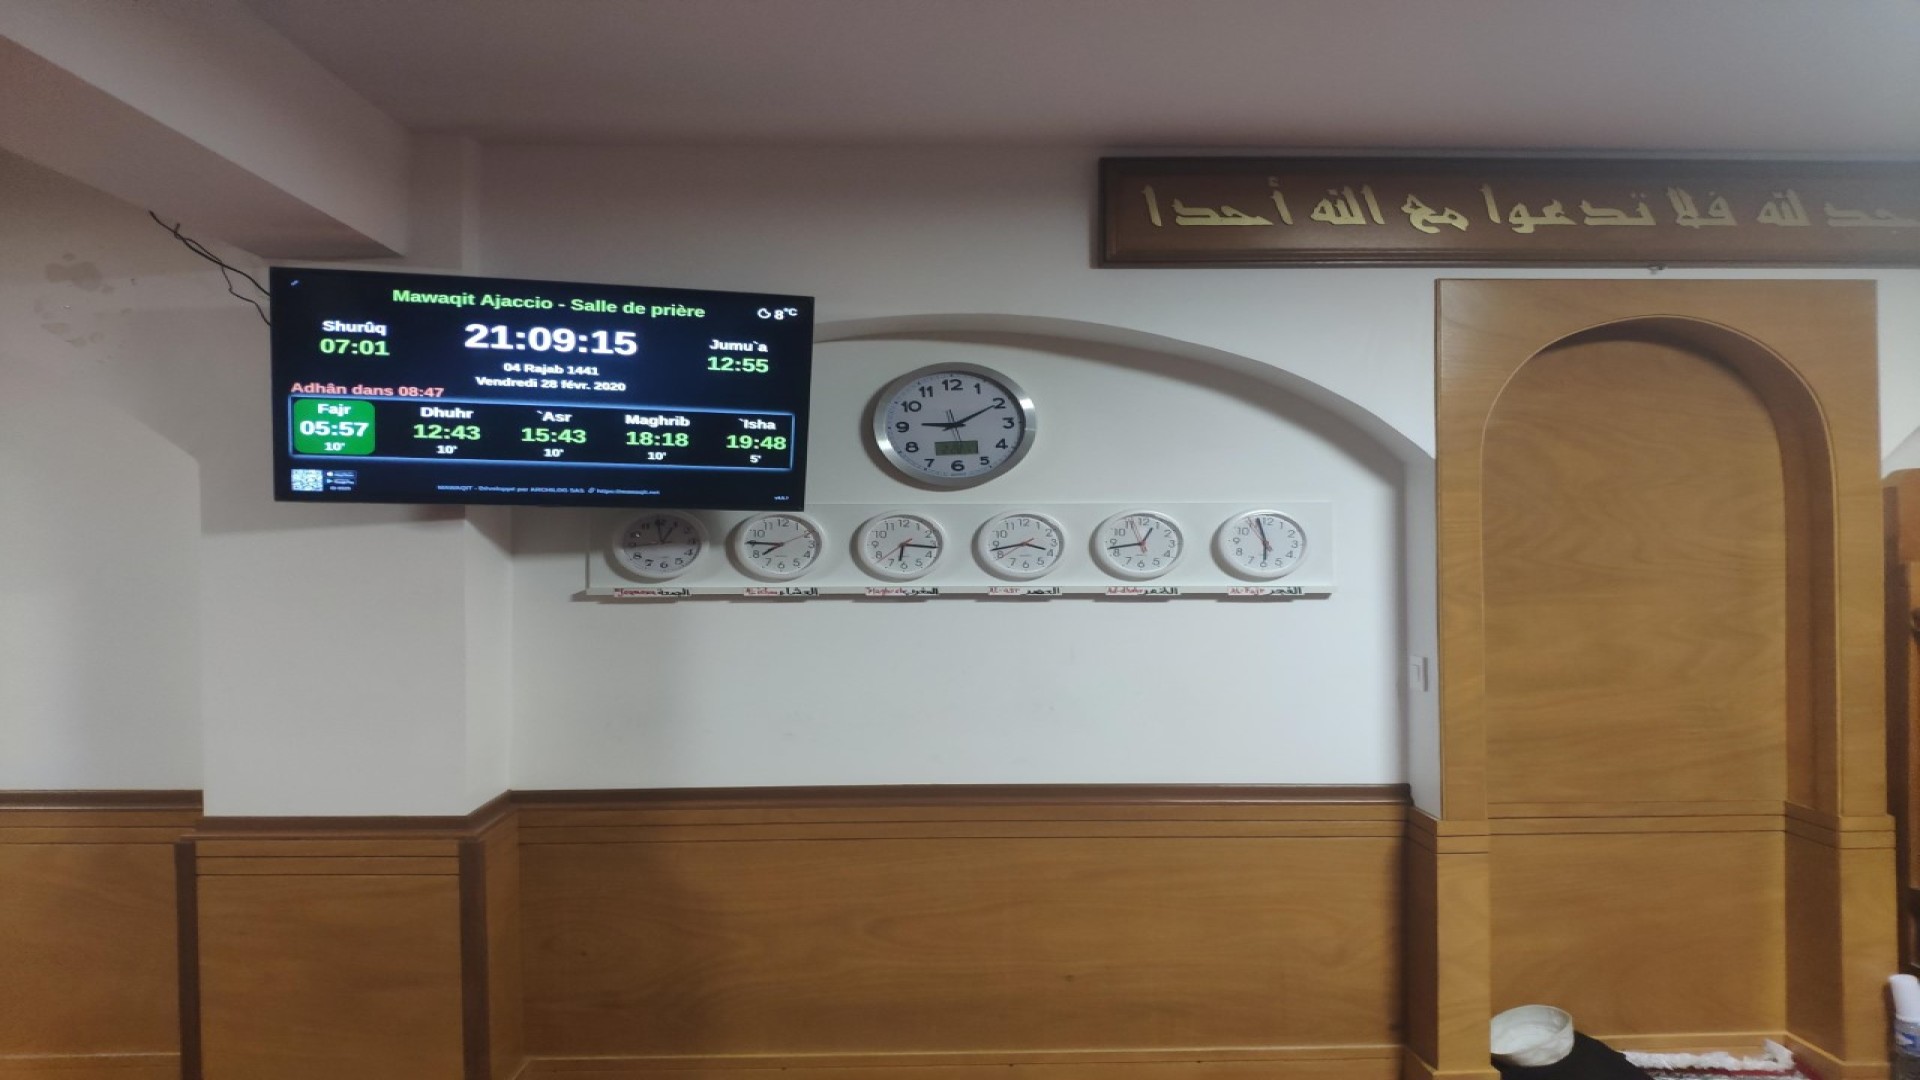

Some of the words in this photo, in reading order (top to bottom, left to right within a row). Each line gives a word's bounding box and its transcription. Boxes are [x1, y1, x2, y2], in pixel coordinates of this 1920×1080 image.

[1310, 184, 1386, 225] الله
[1667, 185, 1738, 228] فلا
[1401, 193, 1470, 234] مع
[392, 289, 476, 307] Mawaqit
[480, 294, 554, 309] Ajaccio
[571, 298, 618, 314] Salle
[622, 302, 646, 315] de
[651, 304, 706, 318] prière
[322, 320, 387, 336] Shurûq
[464, 322, 638, 356] 21:09:15
[319, 338, 390, 356] 07:01
[503, 362, 521, 372] 04
[524, 363, 565, 376] Rajab
[567, 365, 600, 376] 1441
[707, 356, 769, 374] 12:55
[475, 376, 538, 388] Vendredi
[541, 379, 558, 389] 28
[561, 379, 591, 390] févr.
[593, 381, 627, 392] 2020
[942, 379, 963, 391] 12
[291, 381, 347, 395] Adhân
[352, 384, 393, 397] dans
[398, 386, 445, 398] 08:47
[919, 386, 933, 398] 11
[974, 383, 981, 394] 1
[901, 401, 922, 412] 10
[993, 398, 1006, 409] 2
[317, 403, 352, 417] Fajr
[420, 406, 474, 419] Dhuhr
[625, 414, 691, 428] Maghrib
[1002, 417, 1014, 429] 3
[300, 420, 370, 437] 05:57
[896, 421, 909, 433] 9
[413, 423, 481, 440] 12:43
[521, 427, 587, 443] 15:43
[626, 431, 689, 447] 18:18
[726, 434, 787, 450] 19:48
[905, 441, 919, 453] 8
[995, 438, 1008, 450] 4
[924, 458, 935, 468] 7
[980, 456, 991, 466] 5
[951, 460, 965, 472] 6
[777, 519, 789, 527] 12
[898, 519, 909, 528] 12
[1018, 519, 1030, 527] 12
[1138, 518, 1149, 526] 12
[1262, 517, 1274, 526] 12
[764, 522, 773, 530] 11
[886, 522, 894, 531] 11
[1005, 522, 1014, 530] 11
[752, 530, 765, 538] 10
[874, 530, 887, 538] 10
[925, 530, 932, 538] 2
[994, 530, 1007, 538] 10
[1045, 529, 1053, 537] 2
[1114, 528, 1125, 536] 10
[1164, 529, 1171, 537] 2
[1237, 527, 1249, 535] 10
[1287, 529, 1295, 538] 2
[808, 540, 815, 548] 3
[871, 540, 879, 548] 9
[993, 540, 999, 548] 9
[1051, 538, 1058, 547] 3
[1110, 538, 1117, 547] 9
[1168, 540, 1175, 548] 3
[1291, 540, 1298, 548] 3
[684, 548, 693, 556] 4
[753, 550, 759, 558] 8
[804, 550, 811, 558] 4
[1047, 549, 1053, 557] 4
[1113, 549, 1120, 557] 8
[1236, 548, 1242, 556] 8
[1285, 550, 1293, 558] 4
[675, 557, 683, 565] 5
[765, 558, 771, 566] 7
[793, 559, 800, 567] 5
[888, 558, 894, 566] 7
[1009, 558, 1016, 566] 7
[1022, 560, 1029, 568] 6
[1037, 557, 1044, 565] 5
[1125, 556, 1131, 564] 7
[1137, 560, 1145, 568] 6
[1152, 558, 1160, 566] 5
[1275, 558, 1283, 566] 5
[777, 561, 785, 569] 6
